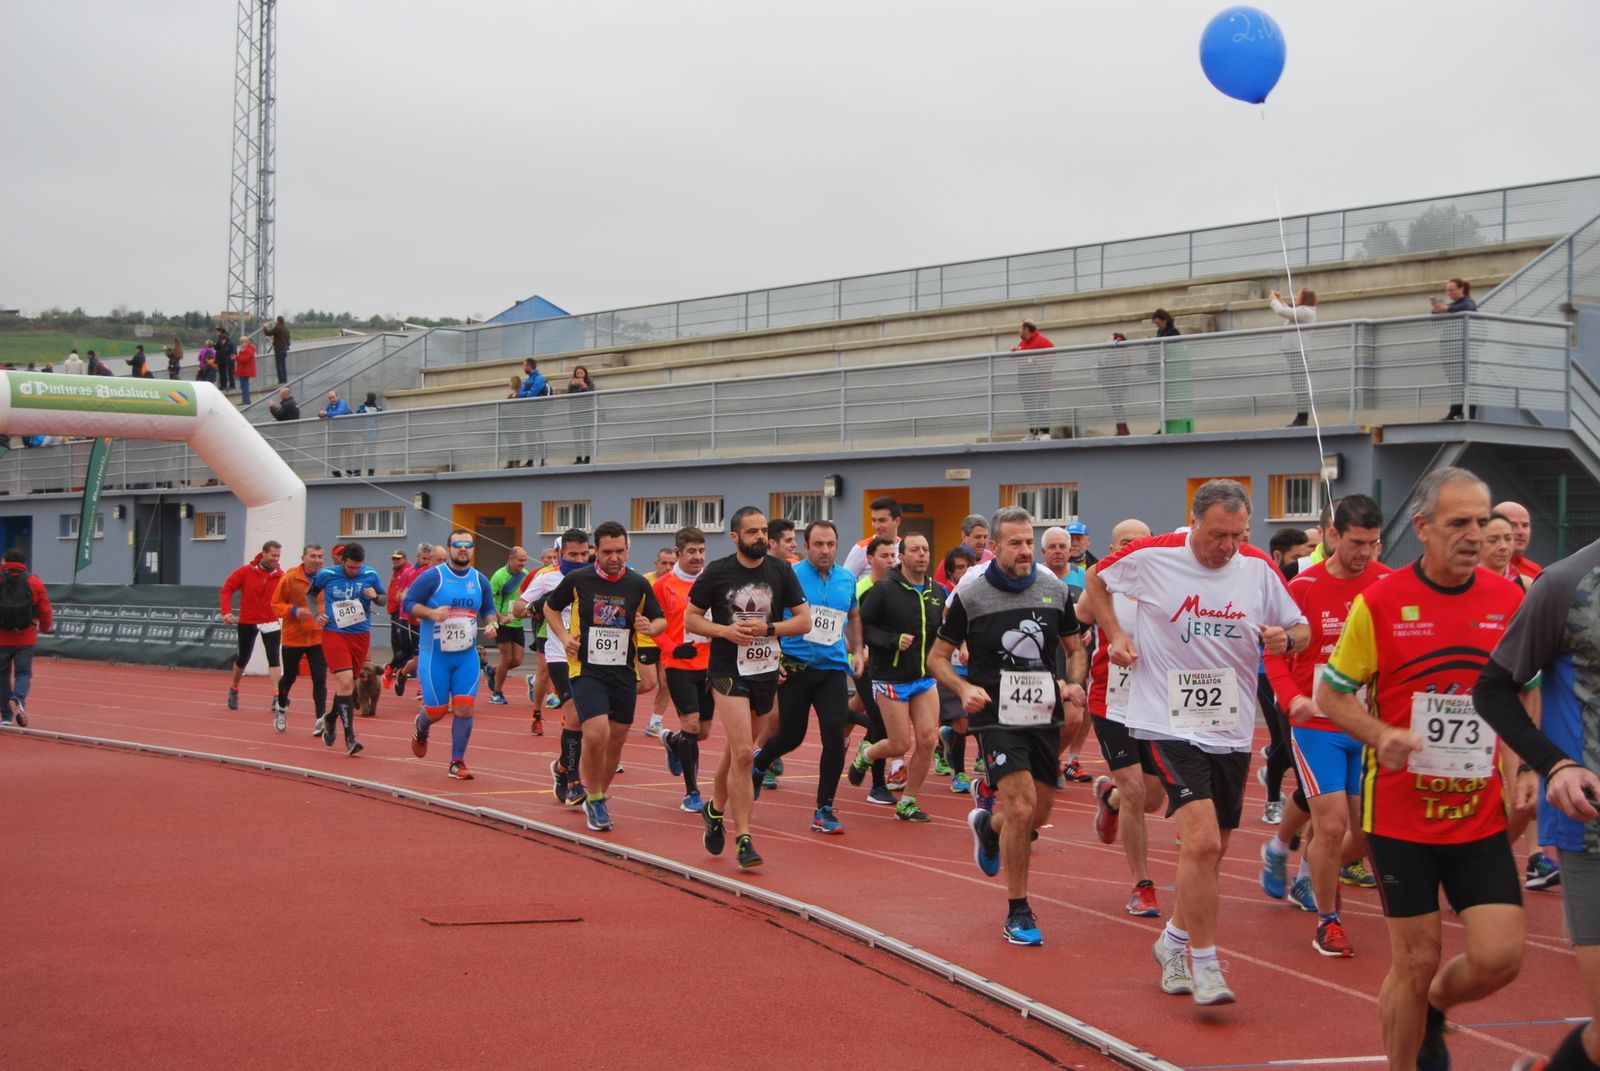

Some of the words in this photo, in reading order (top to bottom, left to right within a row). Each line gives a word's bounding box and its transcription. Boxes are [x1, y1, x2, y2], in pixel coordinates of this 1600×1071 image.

[33, 381, 92, 396] Pinturas
[451, 598, 474, 607] SITO
[1169, 594, 1246, 623] Maraton
[339, 606, 356, 617] 840
[814, 617, 835, 631] 681
[446, 630, 466, 640] 215
[596, 639, 618, 650] 691
[746, 647, 772, 660] 690
[1010, 675, 1020, 685] IV
[1119, 672, 1131, 687] 7
[1179, 674, 1191, 685] IV
[1010, 688, 1043, 704] 442
[1181, 687, 1222, 707] 792
[1427, 698, 1445, 713] IV
[1427, 717, 1479, 744] 973
[1416, 774, 1488, 793] Lokas
[1422, 794, 1479, 820] Trail
